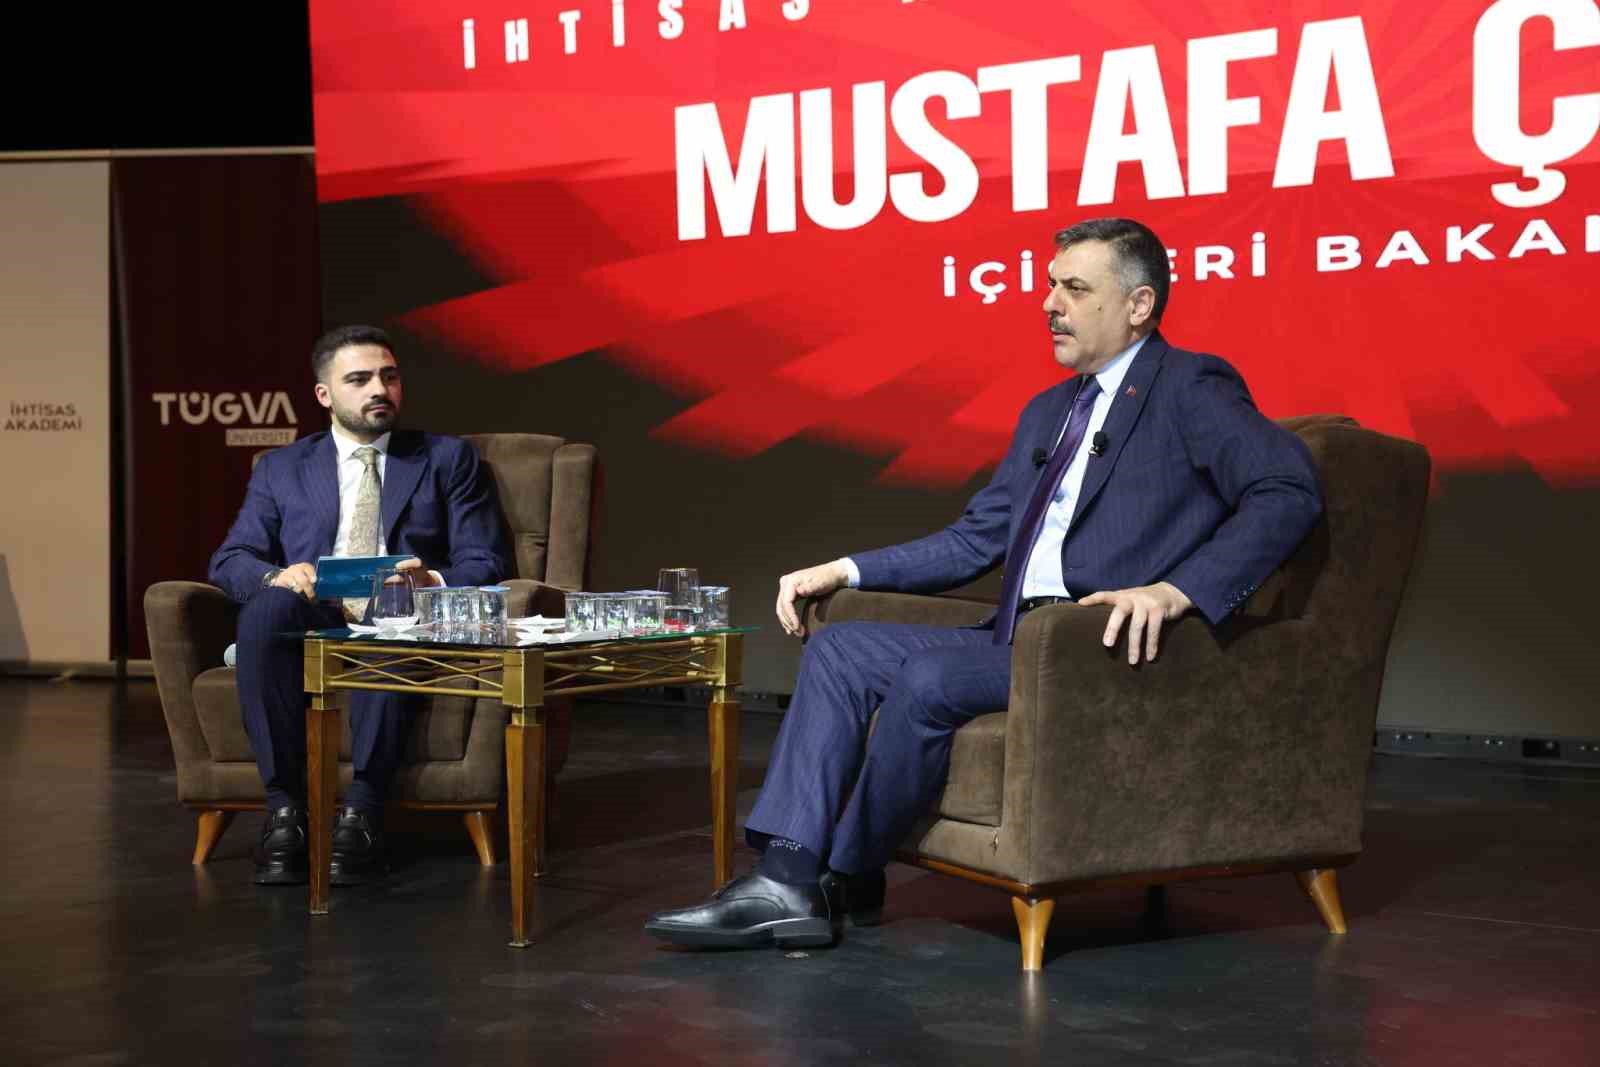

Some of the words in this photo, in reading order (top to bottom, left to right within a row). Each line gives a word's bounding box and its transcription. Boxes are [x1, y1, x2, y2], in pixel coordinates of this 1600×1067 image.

[674, 15, 1395, 241] MUSTAFA
[8, 400, 77, 417] İHTİSAS
[152, 391, 298, 425] TÜGVA
[4, 416, 83, 431] AKADEMİ
